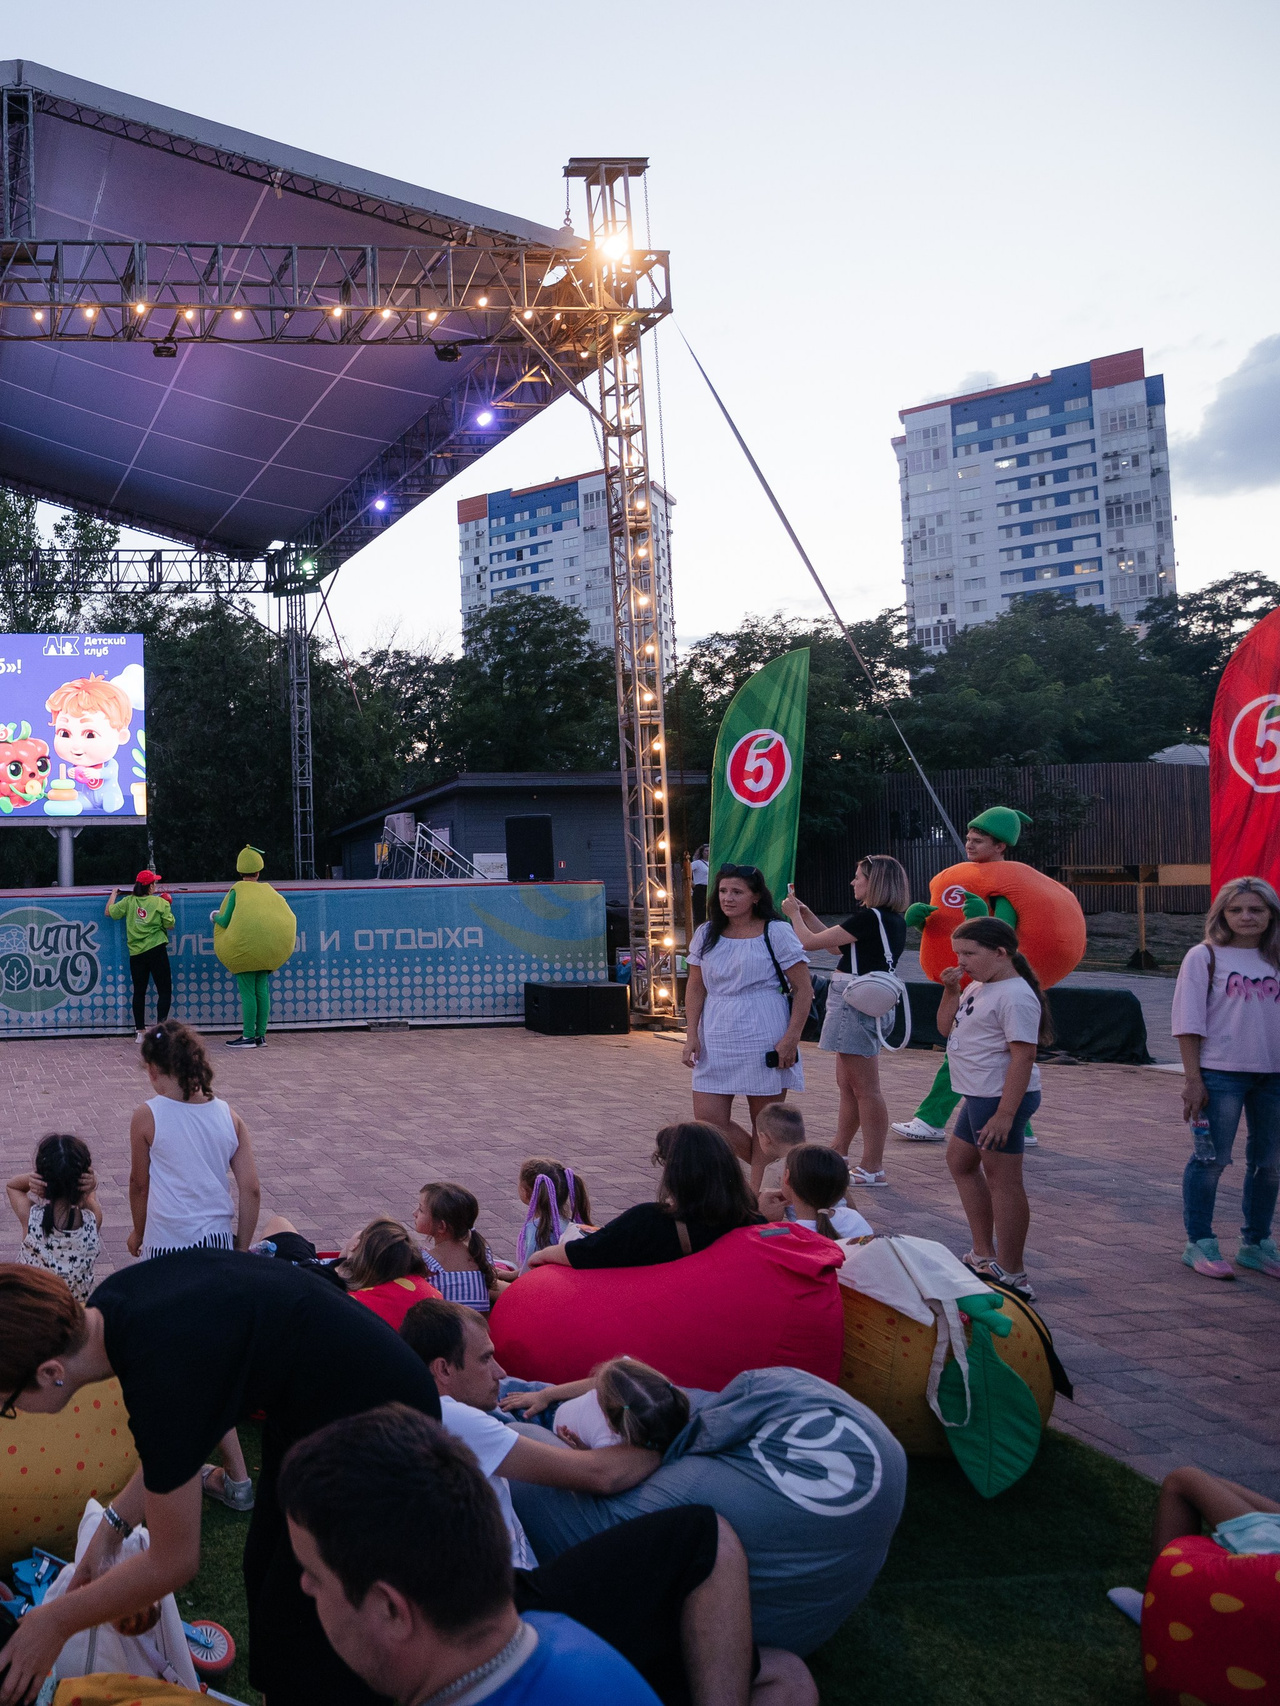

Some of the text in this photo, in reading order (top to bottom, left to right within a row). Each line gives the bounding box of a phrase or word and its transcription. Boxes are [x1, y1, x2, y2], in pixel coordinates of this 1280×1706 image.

[84, 636, 126, 647] Детский
[84, 646, 109, 657] клуб
[29, 923, 97, 957] ЦПК
[320, 930, 340, 952] И
[354, 926, 484, 951] ОТДЫХА
[1226, 971, 1280, 1004] AMO
